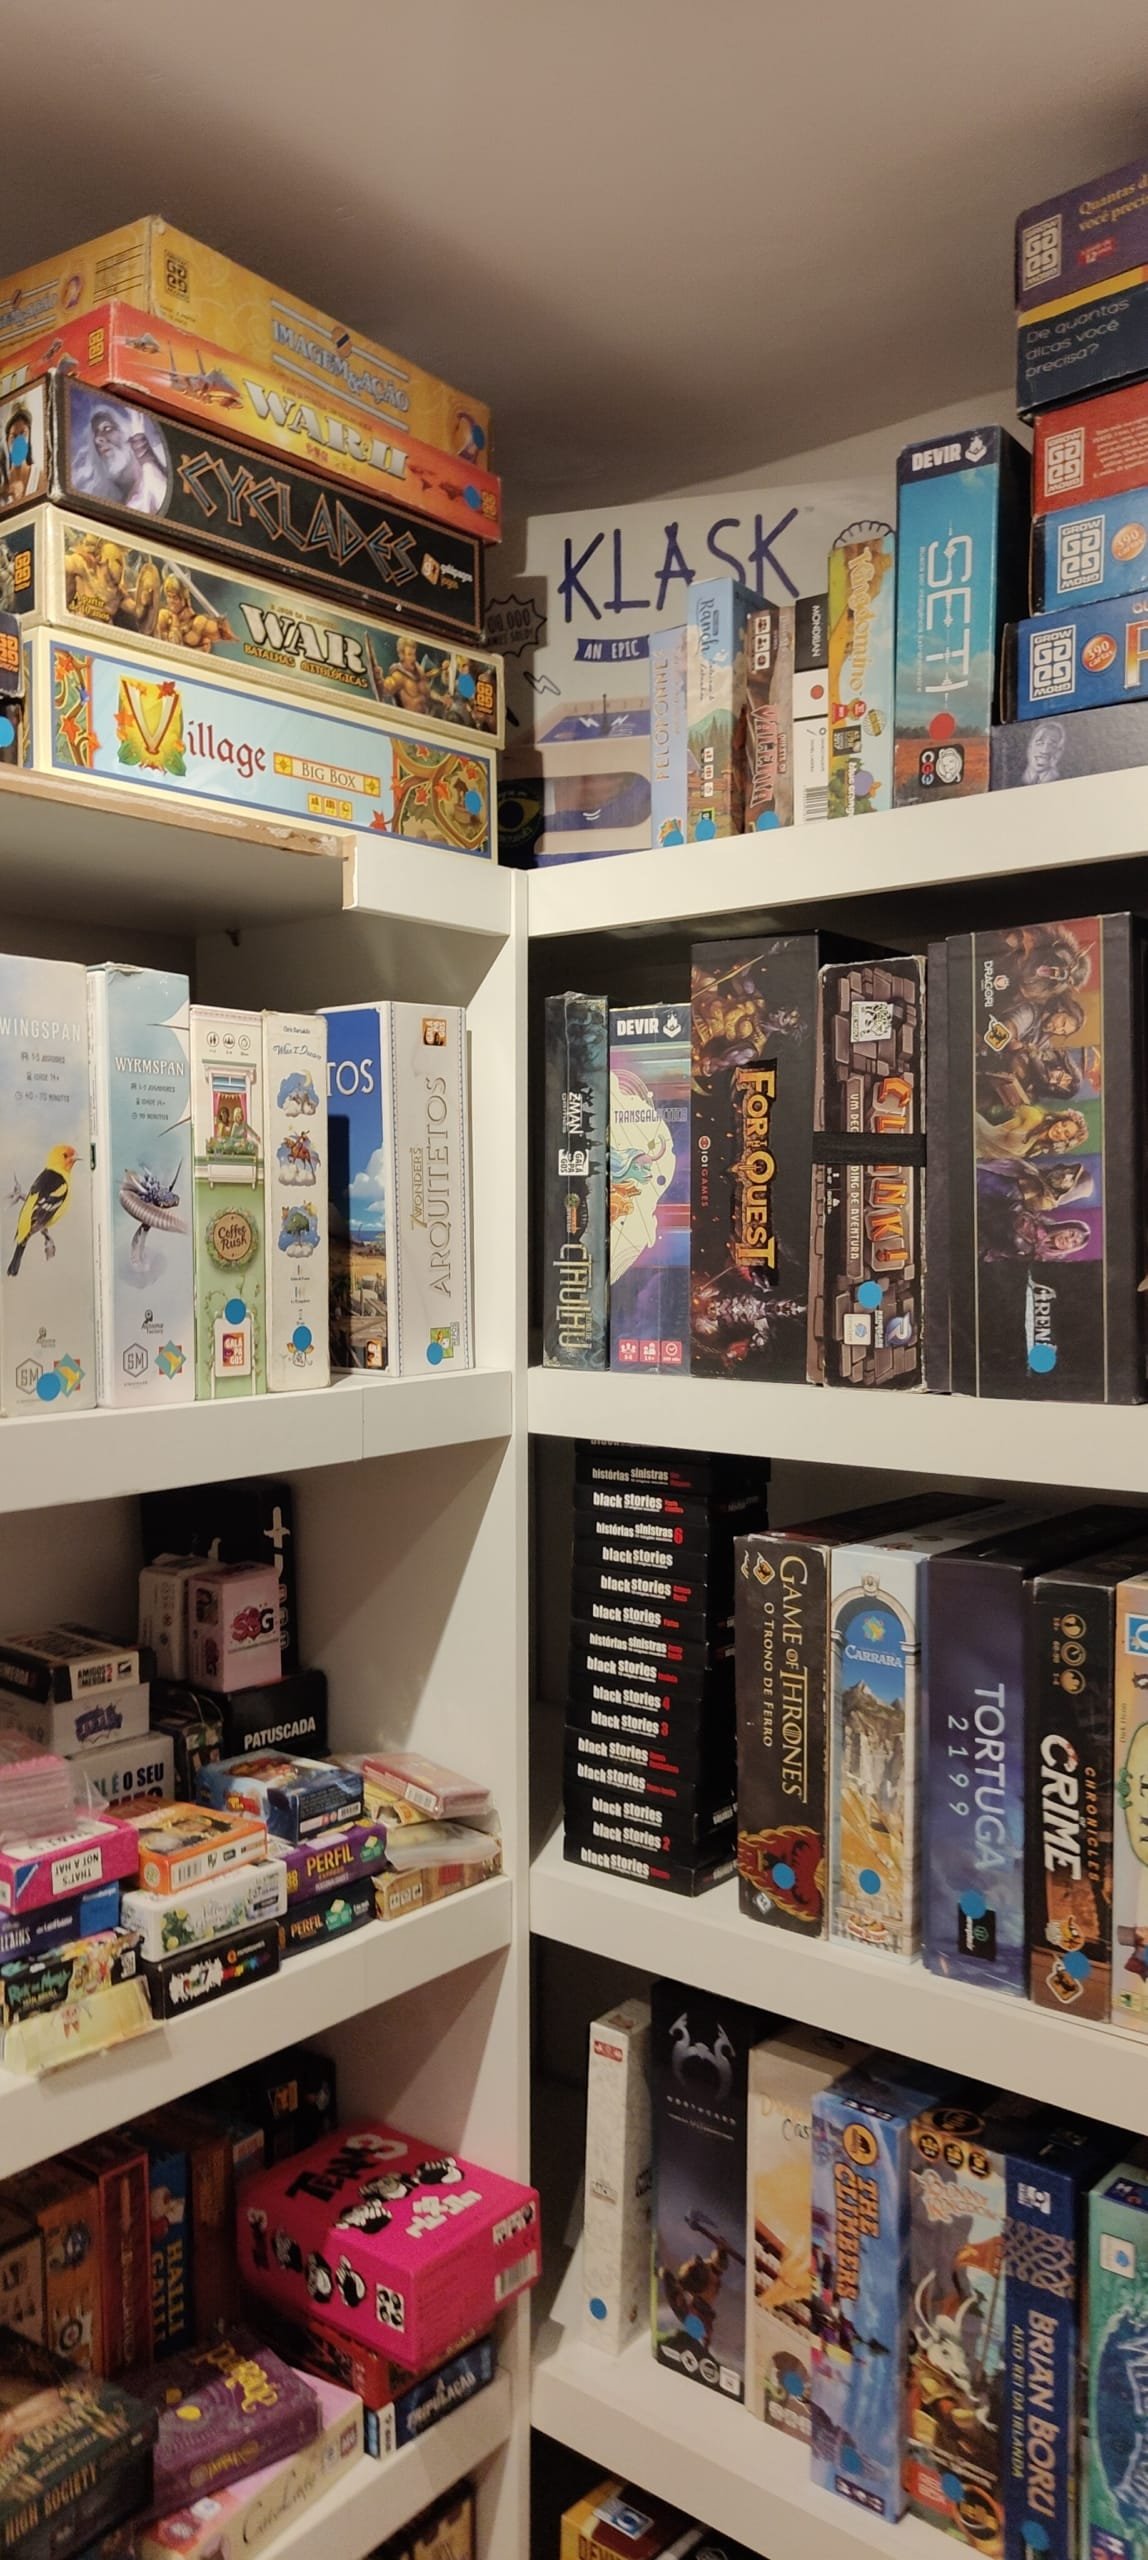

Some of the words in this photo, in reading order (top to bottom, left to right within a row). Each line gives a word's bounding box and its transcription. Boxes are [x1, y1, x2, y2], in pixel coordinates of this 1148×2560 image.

[1027, 327, 1051, 344] De
[1055, 300, 1130, 335] quantas
[1026, 337, 1072, 361] dicas
[1076, 319, 1120, 343] você
[1025, 343, 1100, 382] precisa?
[242, 379, 368, 462] WAR
[911, 443, 962, 471] DEVIR
[177, 452, 419, 587] CYCLADES
[1062, 519, 1101, 537] GROW
[557, 507, 800, 624] KLASK
[925, 535, 973, 693] SETI
[238, 602, 368, 676] WAR
[811, 603, 821, 659] MONDRIAN
[1033, 629, 1072, 644] GROW
[243, 642, 296, 668] BATALHAS
[583, 641, 603, 660] AN
[611, 639, 641, 658] EPIC
[1088, 640, 1110, 661] 390
[1033, 683, 1072, 697] GROW
[121, 680, 267, 779] Village
[300, 762, 326, 782] BIG
[329, 768, 358, 789] BOX
[983, 960, 994, 1008] DRAGORI
[0, 1015, 81, 1042] WINGSPAN
[616, 1017, 659, 1037] DEVIR
[115, 1056, 185, 1077] WYRMSPAN
[424, 1075, 451, 1299] ARQUITETOS
[217, 1222, 248, 1242] Coffee
[220, 1234, 249, 1250] Rush
[592, 1467, 630, 1482] histórias
[630, 1467, 669, 1480] sinistras
[593, 1491, 623, 1509] black
[623, 1493, 663, 1510] stories
[596, 1521, 634, 1538] histórias
[635, 1523, 673, 1538] sinistras
[673, 1527, 684, 1544] 6
[602, 1546, 632, 1565] black
[632, 1549, 673, 1567] stories
[600, 1575, 631, 1593] black
[631, 1578, 672, 1596] stories
[763, 1601, 775, 1614] O
[779, 1555, 808, 1644] GAME
[592, 1603, 622, 1622] black
[622, 1607, 662, 1626] stories
[589, 1632, 628, 1650] histórias
[628, 1635, 667, 1653] sinistras
[762, 1616, 774, 1672] TRONO
[587, 1655, 617, 1675] black
[617, 1659, 658, 1679] stories
[844, 1644, 903, 1669] CARRARA
[593, 1685, 622, 1704] black
[622, 1689, 662, 1709] stories
[662, 1696, 671, 1710] 4
[762, 1675, 774, 1694] DE
[244, 1716, 317, 1751] PATUSCADA
[591, 1710, 620, 1730] black
[621, 1714, 660, 1734] stories
[660, 1721, 669, 1737] 3
[762, 1697, 774, 1748] FERRO
[779, 1667, 808, 1803] THRONES
[578, 1737, 608, 1757] black
[609, 1741, 649, 1763] stories
[137, 1762, 165, 1788] SEU
[577, 1763, 606, 1783] black
[606, 1768, 646, 1790] stories
[973, 1683, 1006, 1871] TORTUGA
[592, 1797, 622, 1817] black
[622, 1802, 663, 1824] stories
[1040, 1734, 1081, 1881] CRIME
[593, 1821, 622, 1843] black
[622, 1827, 662, 1849] stories
[662, 1836, 671, 1851] 2
[1084, 1766, 1098, 1882] CHRONICLES
[306, 1843, 355, 1877] PERFIL
[580, 1847, 610, 1869] black
[610, 1853, 650, 1876] stories
[291, 1914, 323, 1939] PERFIL
[857, 2174, 880, 2241] THE
[833, 2161, 862, 2300] CLIMBERS
[1012, 2324, 1025, 2359] ALTO
[1027, 2309, 1059, 2412] BRIAN
[1012, 2390, 1025, 2410] DA
[1011, 2414, 1024, 2479] IRLANDA
[1026, 2412, 1061, 2519] BORU
